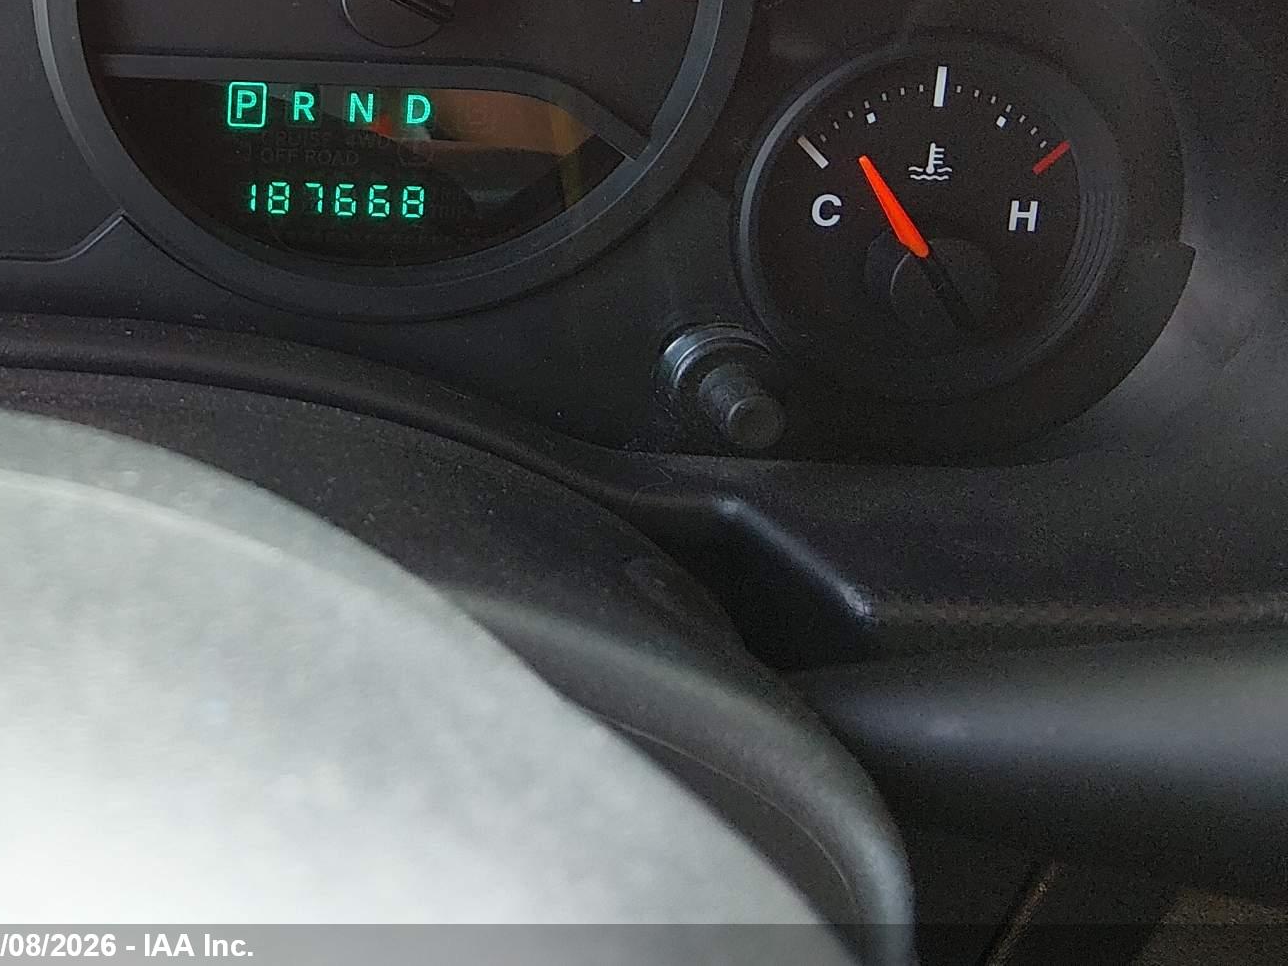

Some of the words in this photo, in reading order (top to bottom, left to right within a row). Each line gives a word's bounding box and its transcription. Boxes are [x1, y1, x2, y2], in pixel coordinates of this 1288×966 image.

[235, 89, 258, 120] P
[293, 91, 315, 122] R
[348, 93, 374, 124] N
[405, 94, 432, 126] D
[249, 181, 425, 219] 187668
[811, 193, 842, 227] C
[1008, 200, 1039, 232] H
